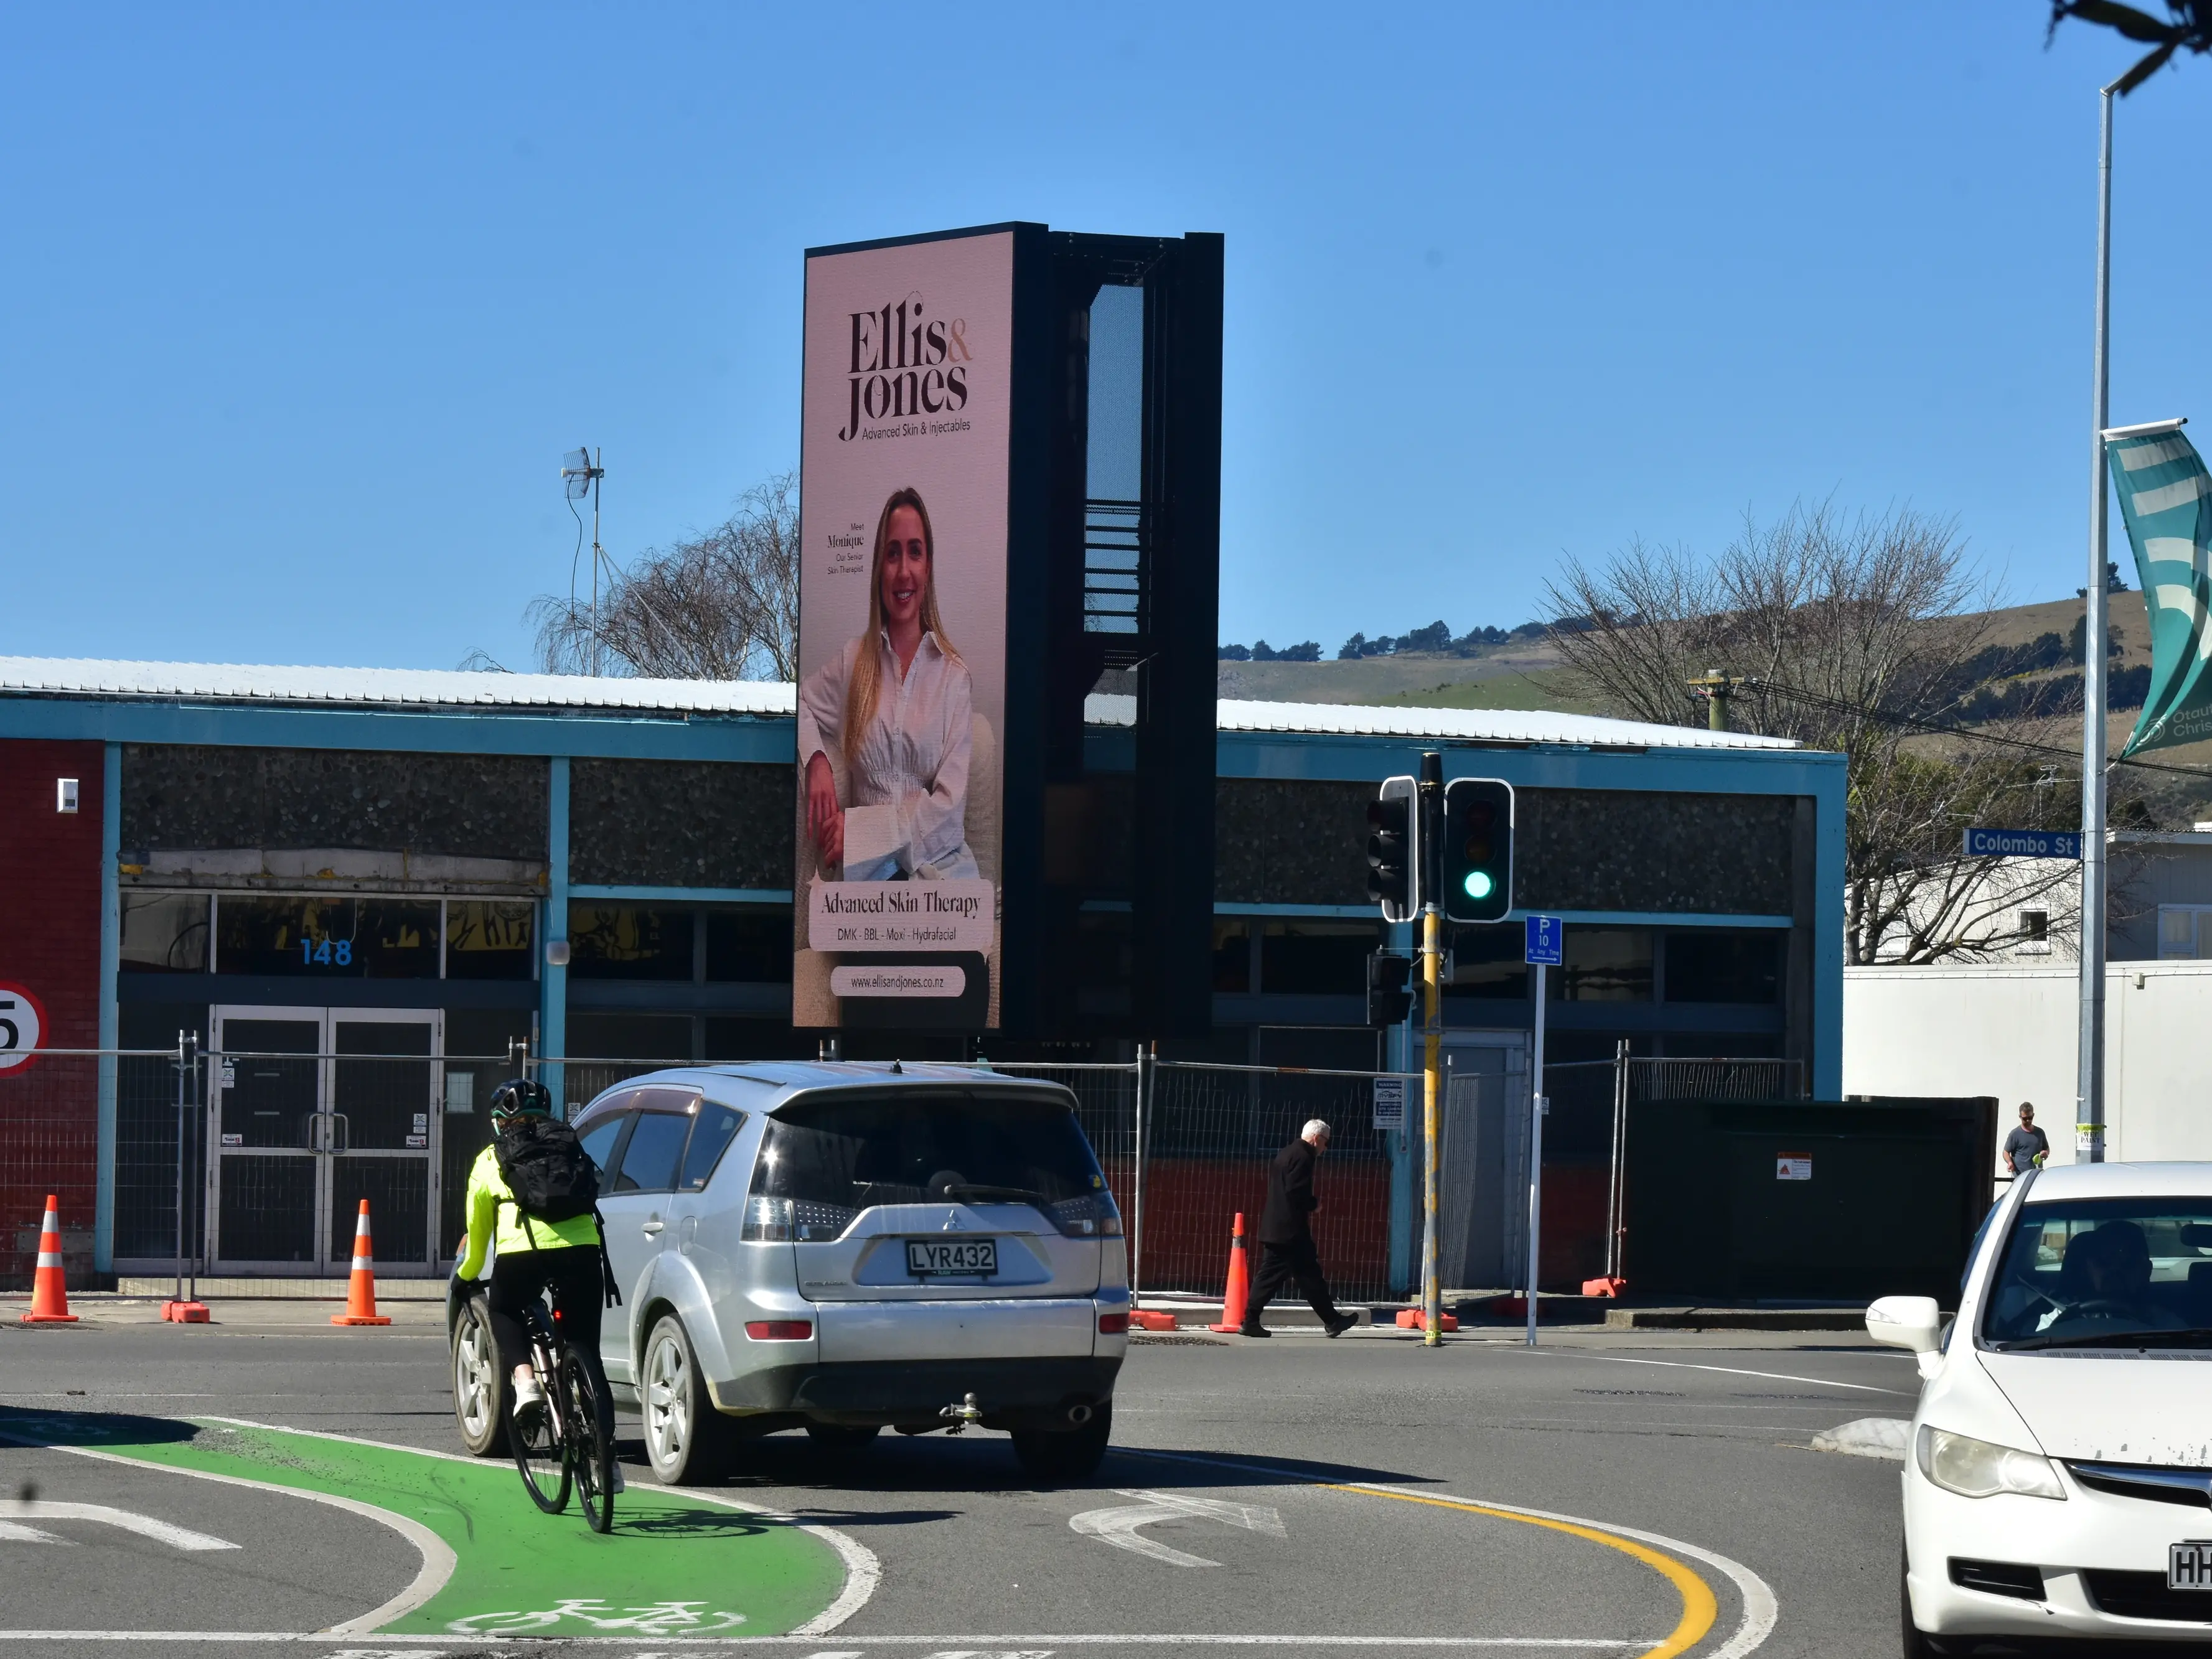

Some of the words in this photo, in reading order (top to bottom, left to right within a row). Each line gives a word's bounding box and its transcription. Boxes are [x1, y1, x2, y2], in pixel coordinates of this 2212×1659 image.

[838, 367, 967, 441] Jones
[862, 424, 900, 440] Advanced
[902, 423, 918, 436] Skin
[921, 424, 927, 435] &
[929, 418, 970, 437] Injectables
[851, 523, 864, 531] Meet
[828, 534, 864, 549] Monique
[847, 553, 863, 561] Senior
[828, 566, 838, 574] Skin
[840, 565, 863, 574] Therapist
[1975, 833, 2046, 853] Colombo
[2055, 837, 2073, 854] St
[822, 891, 883, 914] Advanced
[886, 889, 918, 914] Skin
[924, 890, 980, 919] Therapy
[1540, 918, 1550, 933] P
[838, 928, 857, 940] DMK
[864, 928, 879, 940] BBL
[886, 928, 905, 940] Moxi
[912, 927, 956, 943] Hydrafacial
[1539, 935, 1549, 946] 10
[301, 939, 352, 965] 148
[851, 974, 944, 991] www.ellisandjones.co.nz
[912, 1246, 993, 1268] LYR432
